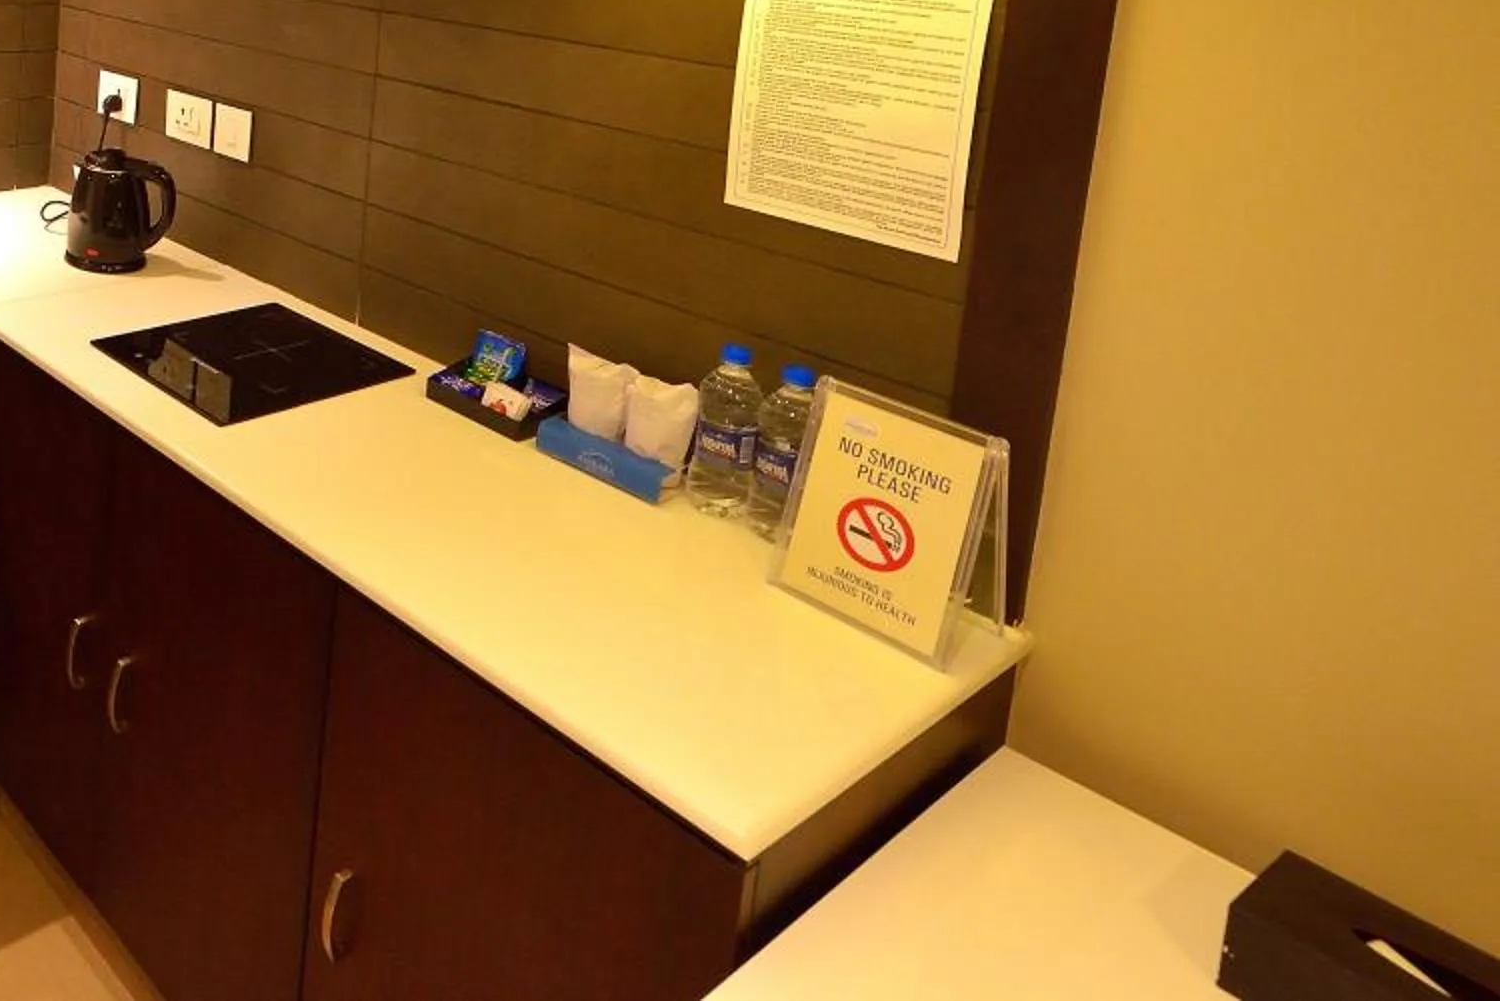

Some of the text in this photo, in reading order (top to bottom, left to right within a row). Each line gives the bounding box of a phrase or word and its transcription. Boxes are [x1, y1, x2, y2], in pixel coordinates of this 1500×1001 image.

[838, 436, 952, 495] NO SMOKING
[856, 463, 922, 504] PLEASE
[834, 565, 893, 602] SMOKING IS
[861, 590, 876, 606] TO
[875, 599, 917, 626] HEALTH
